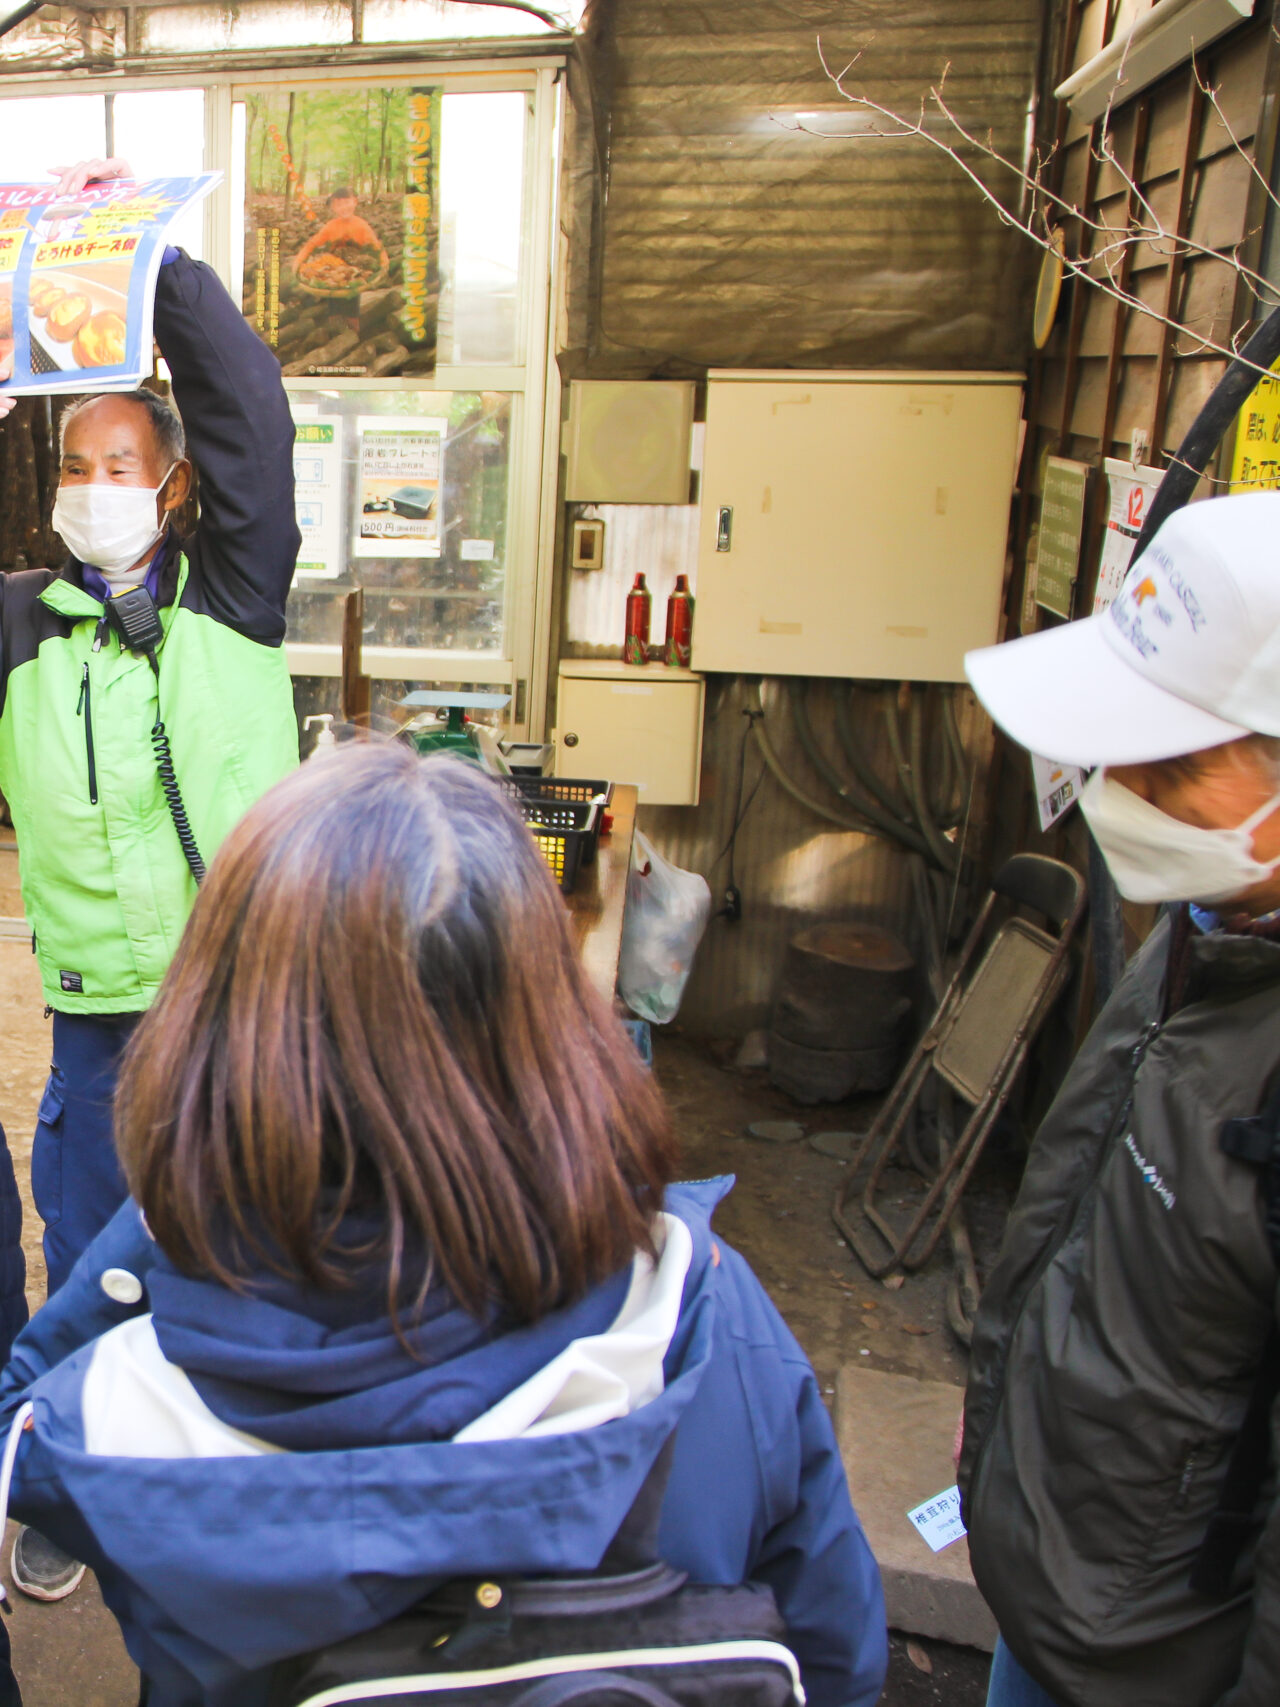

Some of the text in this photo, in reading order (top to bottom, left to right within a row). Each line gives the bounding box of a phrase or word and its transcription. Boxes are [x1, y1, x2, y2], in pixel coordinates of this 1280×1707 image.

[1127, 487, 1145, 528] 12
[914, 1493, 960, 1526] 椎茸狩り
